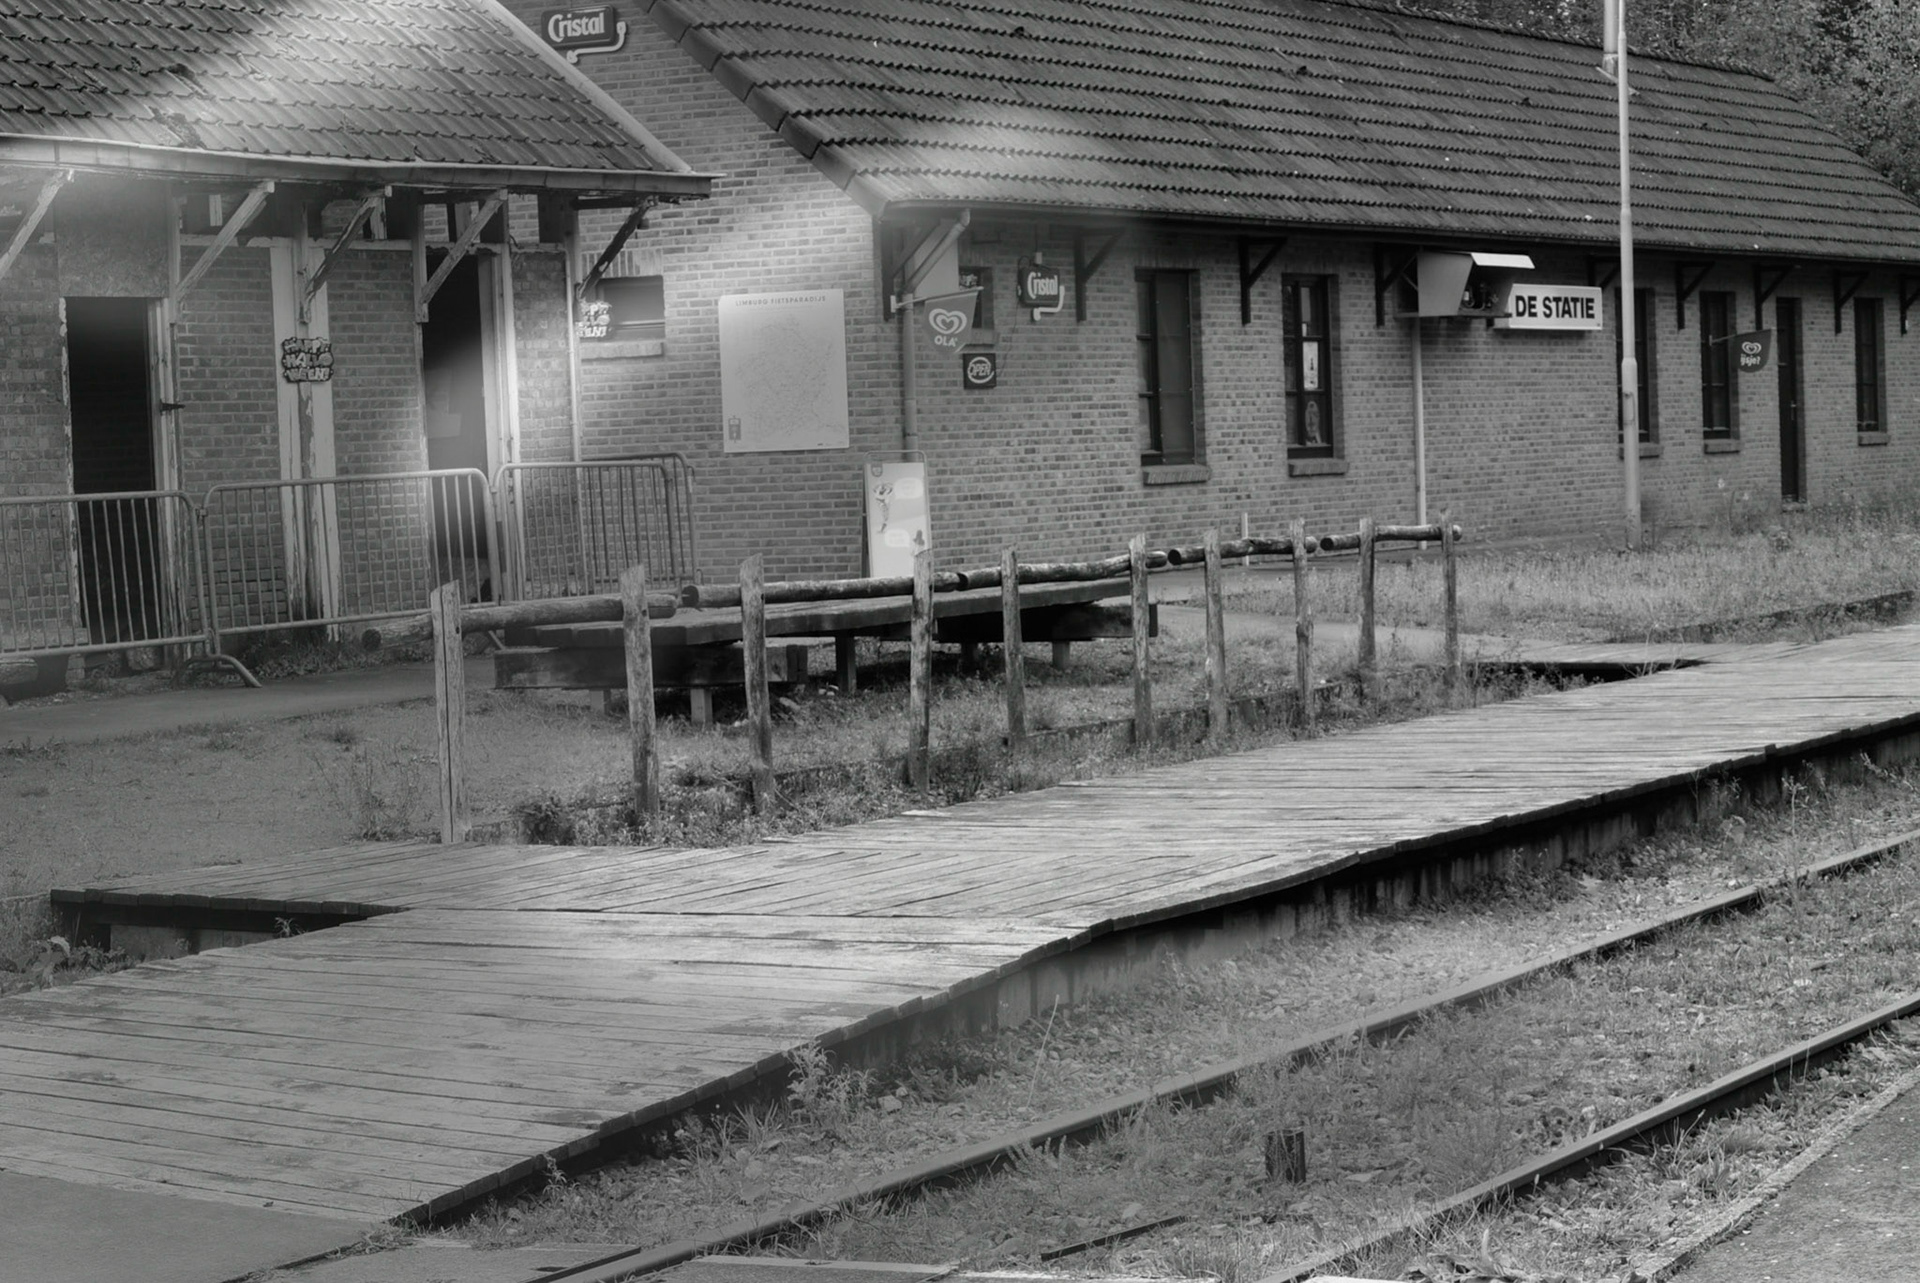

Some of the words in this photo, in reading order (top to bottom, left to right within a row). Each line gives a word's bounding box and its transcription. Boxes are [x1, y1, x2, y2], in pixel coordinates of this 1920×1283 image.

[548, 12, 605, 43] Cristal
[1027, 271, 1058, 299] Cristal
[1515, 295, 1538, 318] DE
[1542, 296, 1595, 319] STATIE
[934, 335, 956, 348] OLA
[967, 363, 992, 377] OPEN
